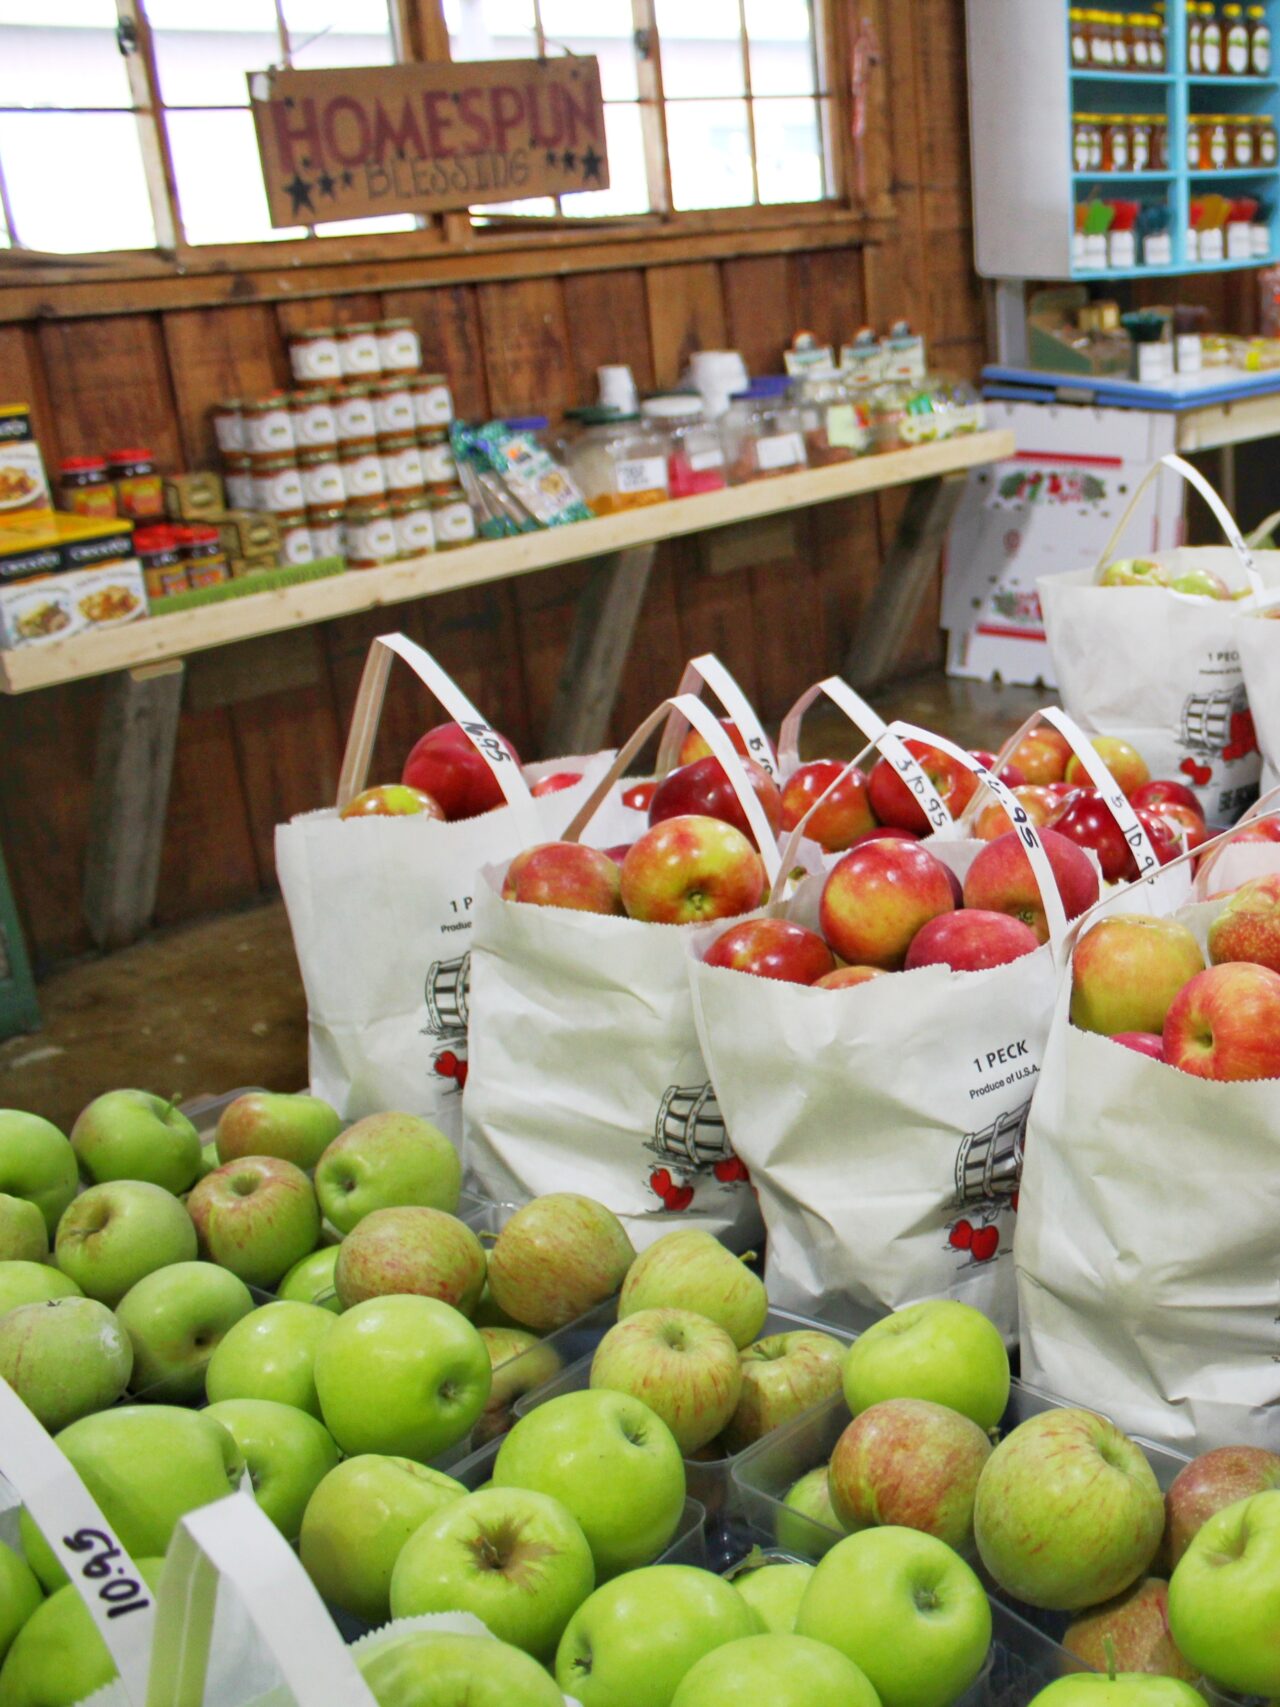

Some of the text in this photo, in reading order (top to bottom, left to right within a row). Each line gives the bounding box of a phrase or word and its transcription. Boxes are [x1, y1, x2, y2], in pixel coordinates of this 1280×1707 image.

[270, 78, 600, 174] HOMESPUN
[364, 150, 531, 200] BLESSING
[449, 899, 458, 913] 1
[973, 1039, 1030, 1073] 1 PECK
[968, 1078, 1006, 1100] Produce
[1005, 1072, 1016, 1085] of
[62, 1527, 151, 1620] 10.95
